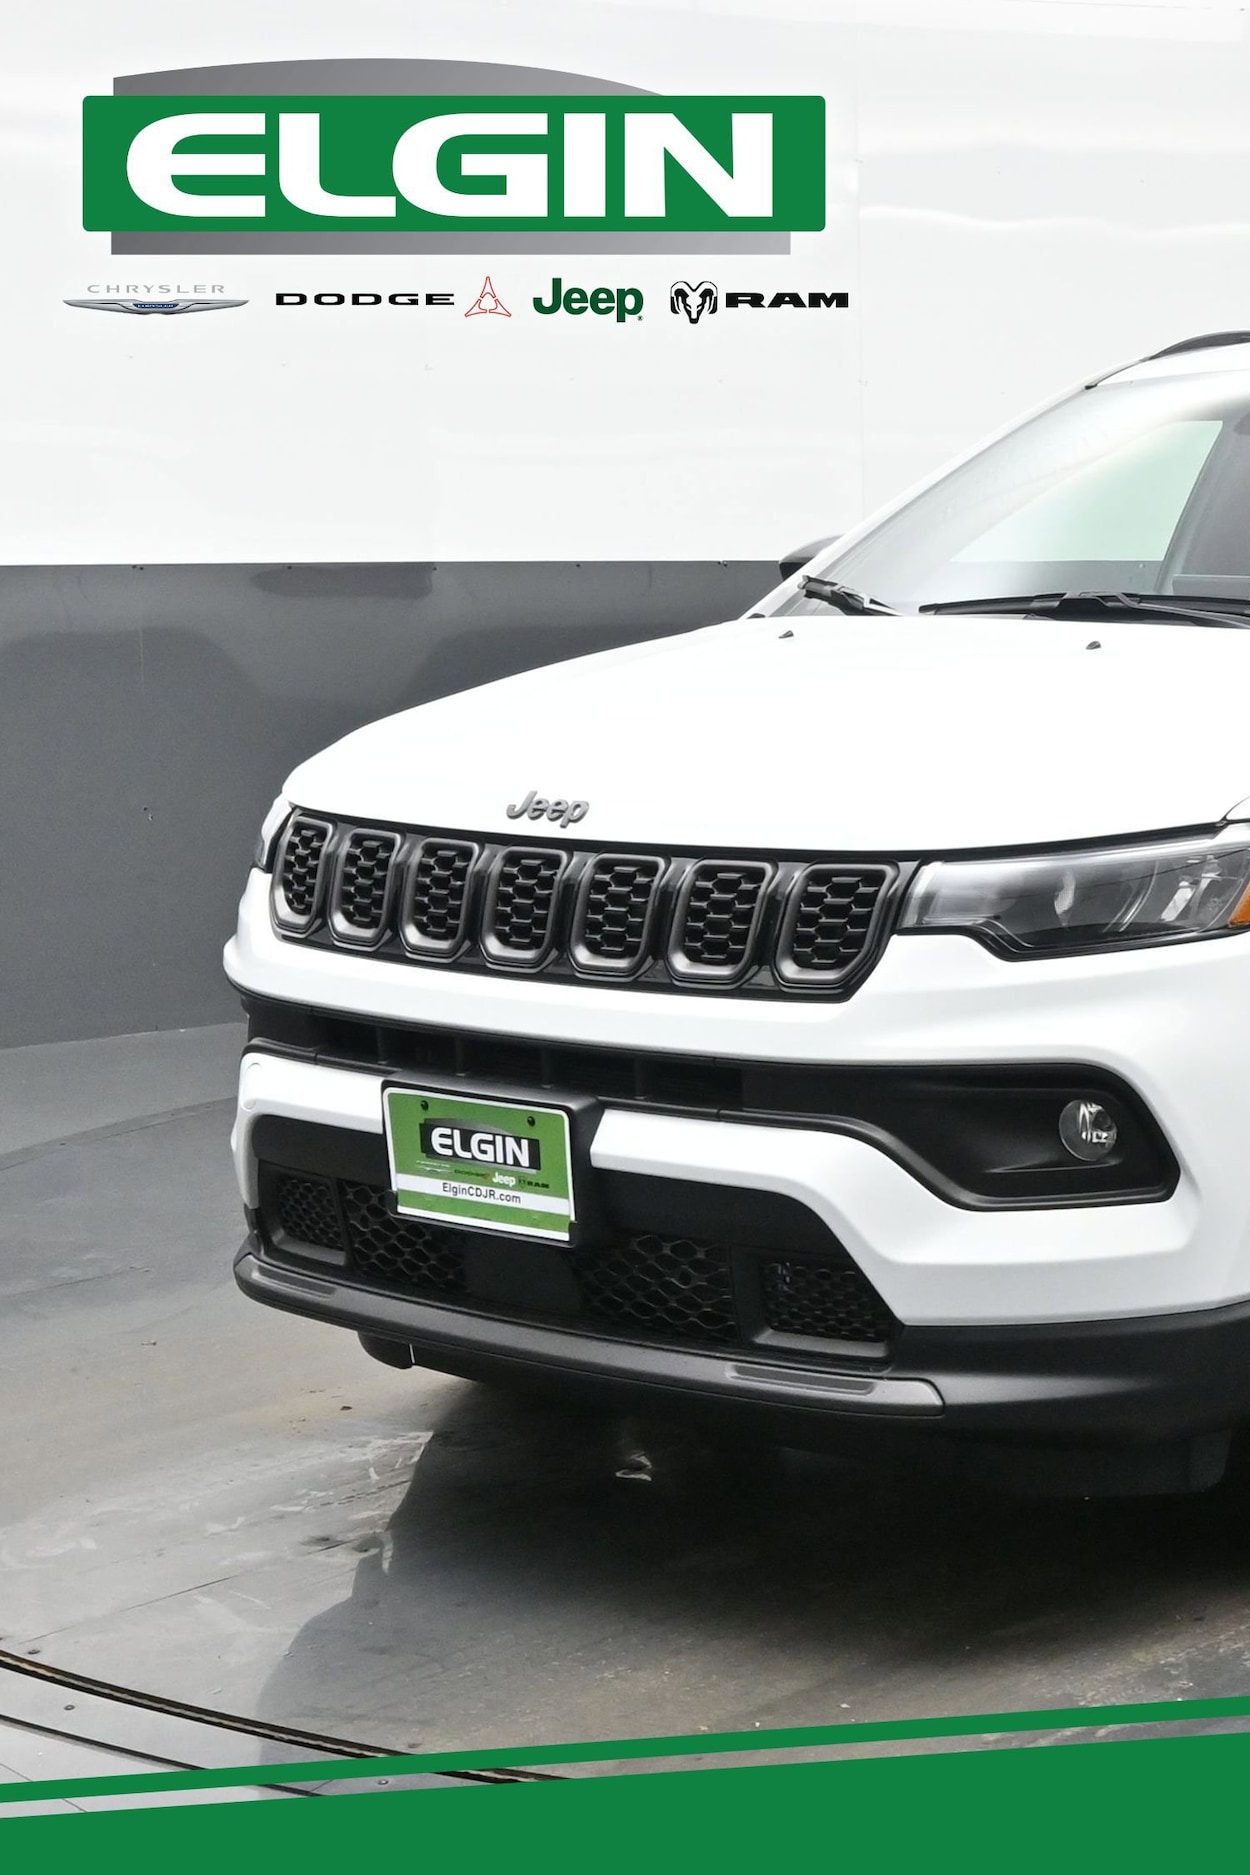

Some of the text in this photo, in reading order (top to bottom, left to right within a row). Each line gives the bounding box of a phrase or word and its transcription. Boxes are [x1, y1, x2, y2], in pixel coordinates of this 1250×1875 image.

[506, 790, 590, 830] Jeep
[430, 1126, 530, 1168] ELGIN
[442, 1182, 522, 1204] ElginCDJR.com
[492, 1171, 516, 1187] Jeep
